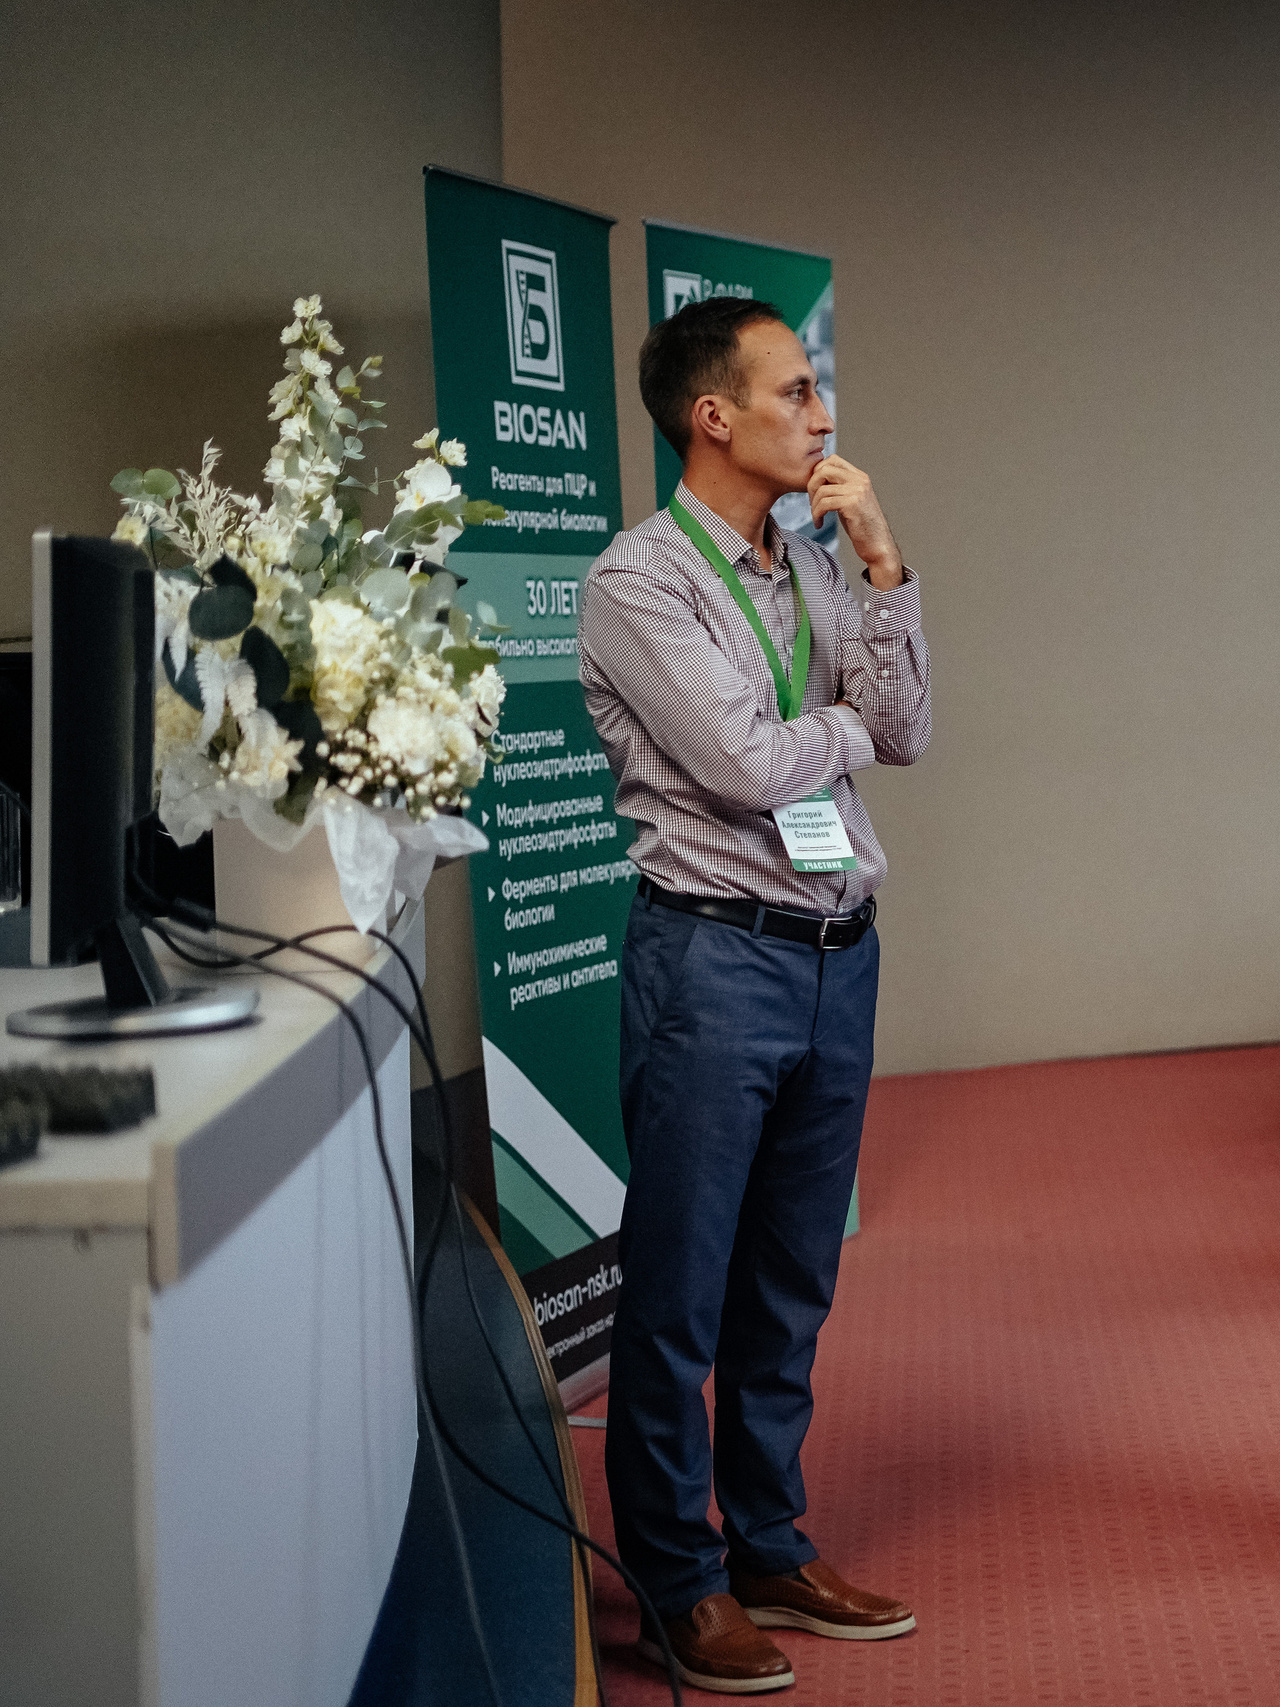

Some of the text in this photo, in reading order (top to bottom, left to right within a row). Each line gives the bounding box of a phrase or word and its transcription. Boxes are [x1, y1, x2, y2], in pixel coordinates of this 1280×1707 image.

[493, 400, 587, 451] BIOSAN
[491, 465, 597, 499] Реагенты для ПЦР и
[560, 508, 608, 532] биологии
[526, 580, 579, 616] 30 ЛЕТ
[536, 637, 579, 656] высоког
[490, 728, 565, 754] Стандартные
[496, 794, 604, 829] Модифицированные
[781, 820, 837, 830] Александрович
[787, 809, 823, 820] Григорий
[499, 818, 618, 861] нуклеозидтрифосфаты
[794, 831, 831, 839] Степанов
[803, 861, 843, 870] УЧАСТНИК
[501, 873, 559, 904] Ферменты
[560, 869, 579, 894] для
[504, 904, 556, 931] биологии
[507, 934, 608, 976] Иммунохимические
[510, 959, 619, 1011] реактивы и антитела
